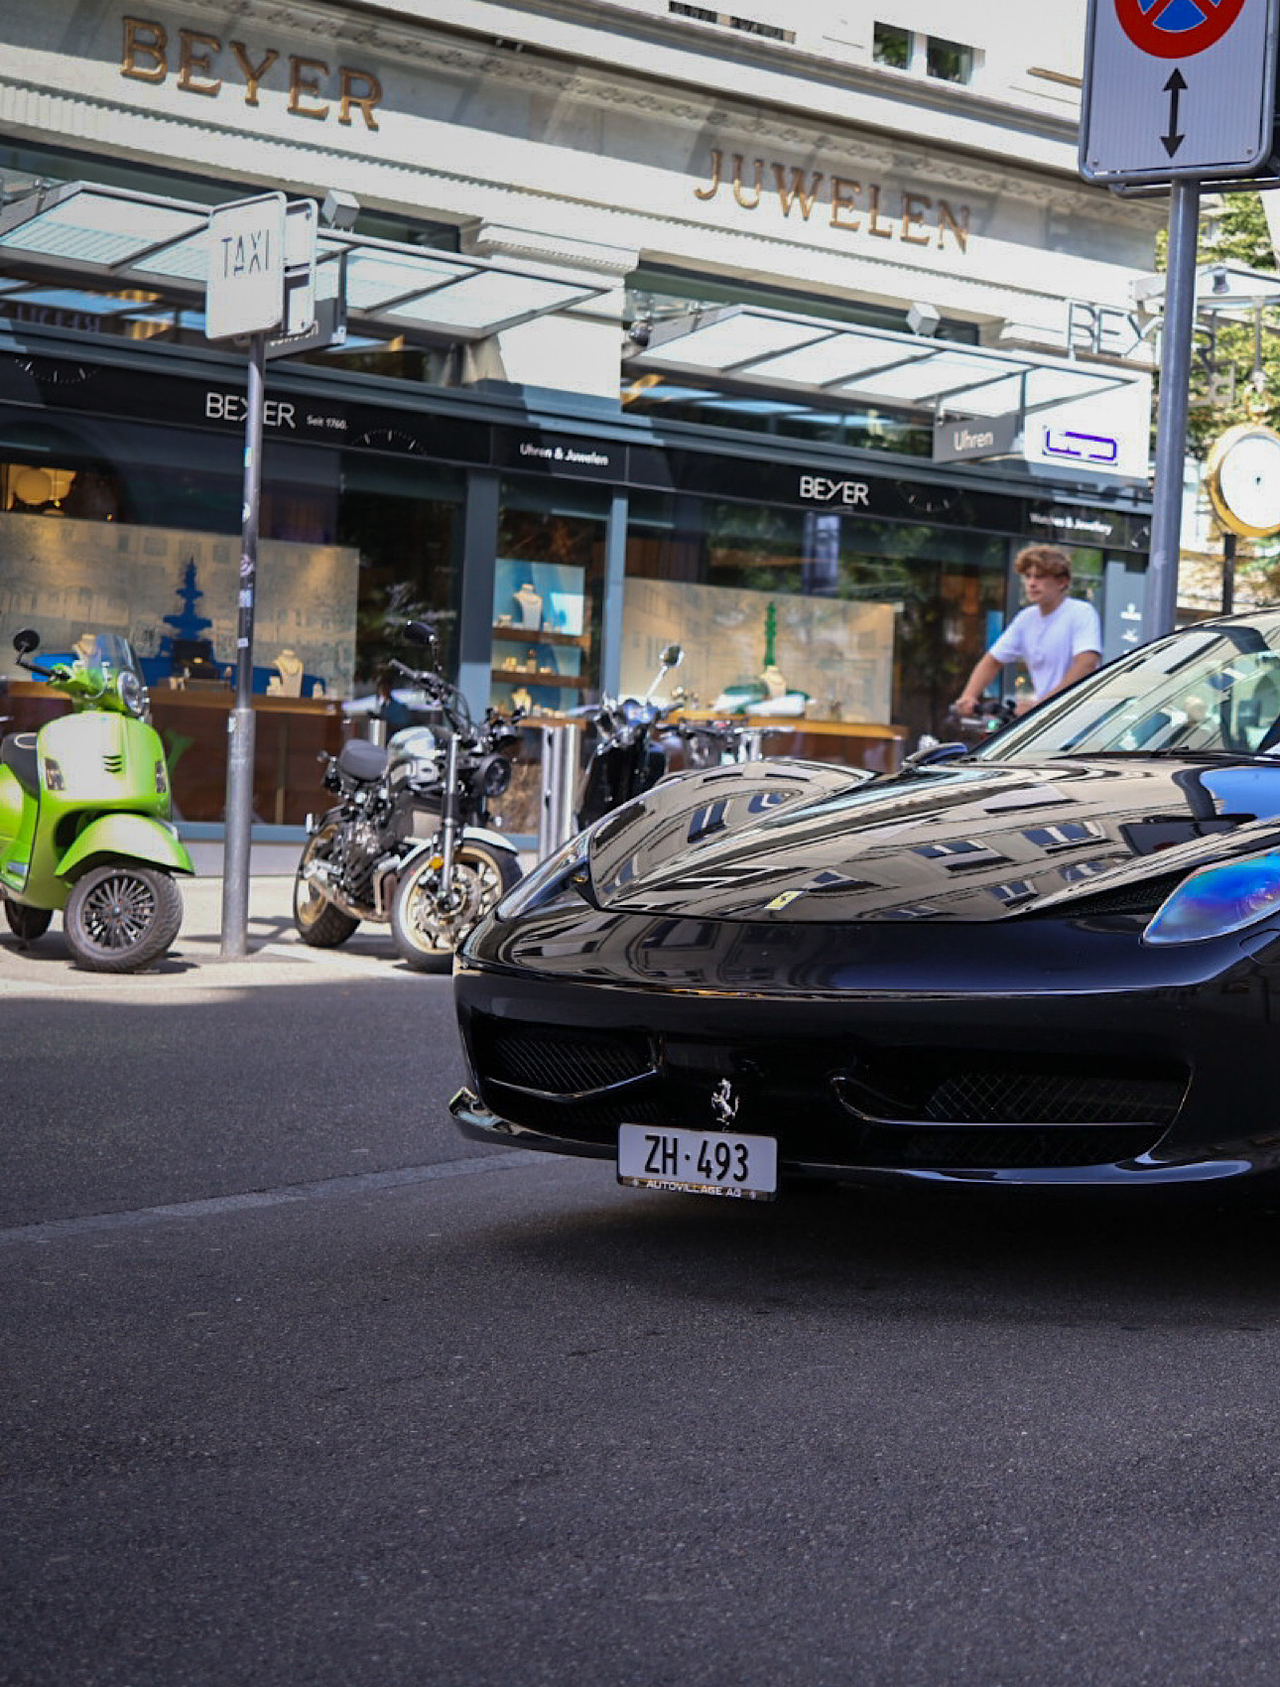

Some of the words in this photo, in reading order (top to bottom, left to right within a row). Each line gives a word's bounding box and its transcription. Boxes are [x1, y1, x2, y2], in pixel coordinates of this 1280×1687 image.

[119, 16, 382, 131] BEYER
[694, 149, 970, 254] JUWELEN
[221, 229, 270, 279] TAXI
[1068, 299, 1218, 378] BEYR
[519, 442, 552, 459] Uhren
[554, 446, 564, 460] &
[565, 449, 609, 466] Juwelen
[954, 429, 994, 451] Uhren
[800, 475, 870, 506] BEYER
[646, 1179, 723, 1196] AUTOVILLAGE
[725, 1187, 742, 1198] AG
